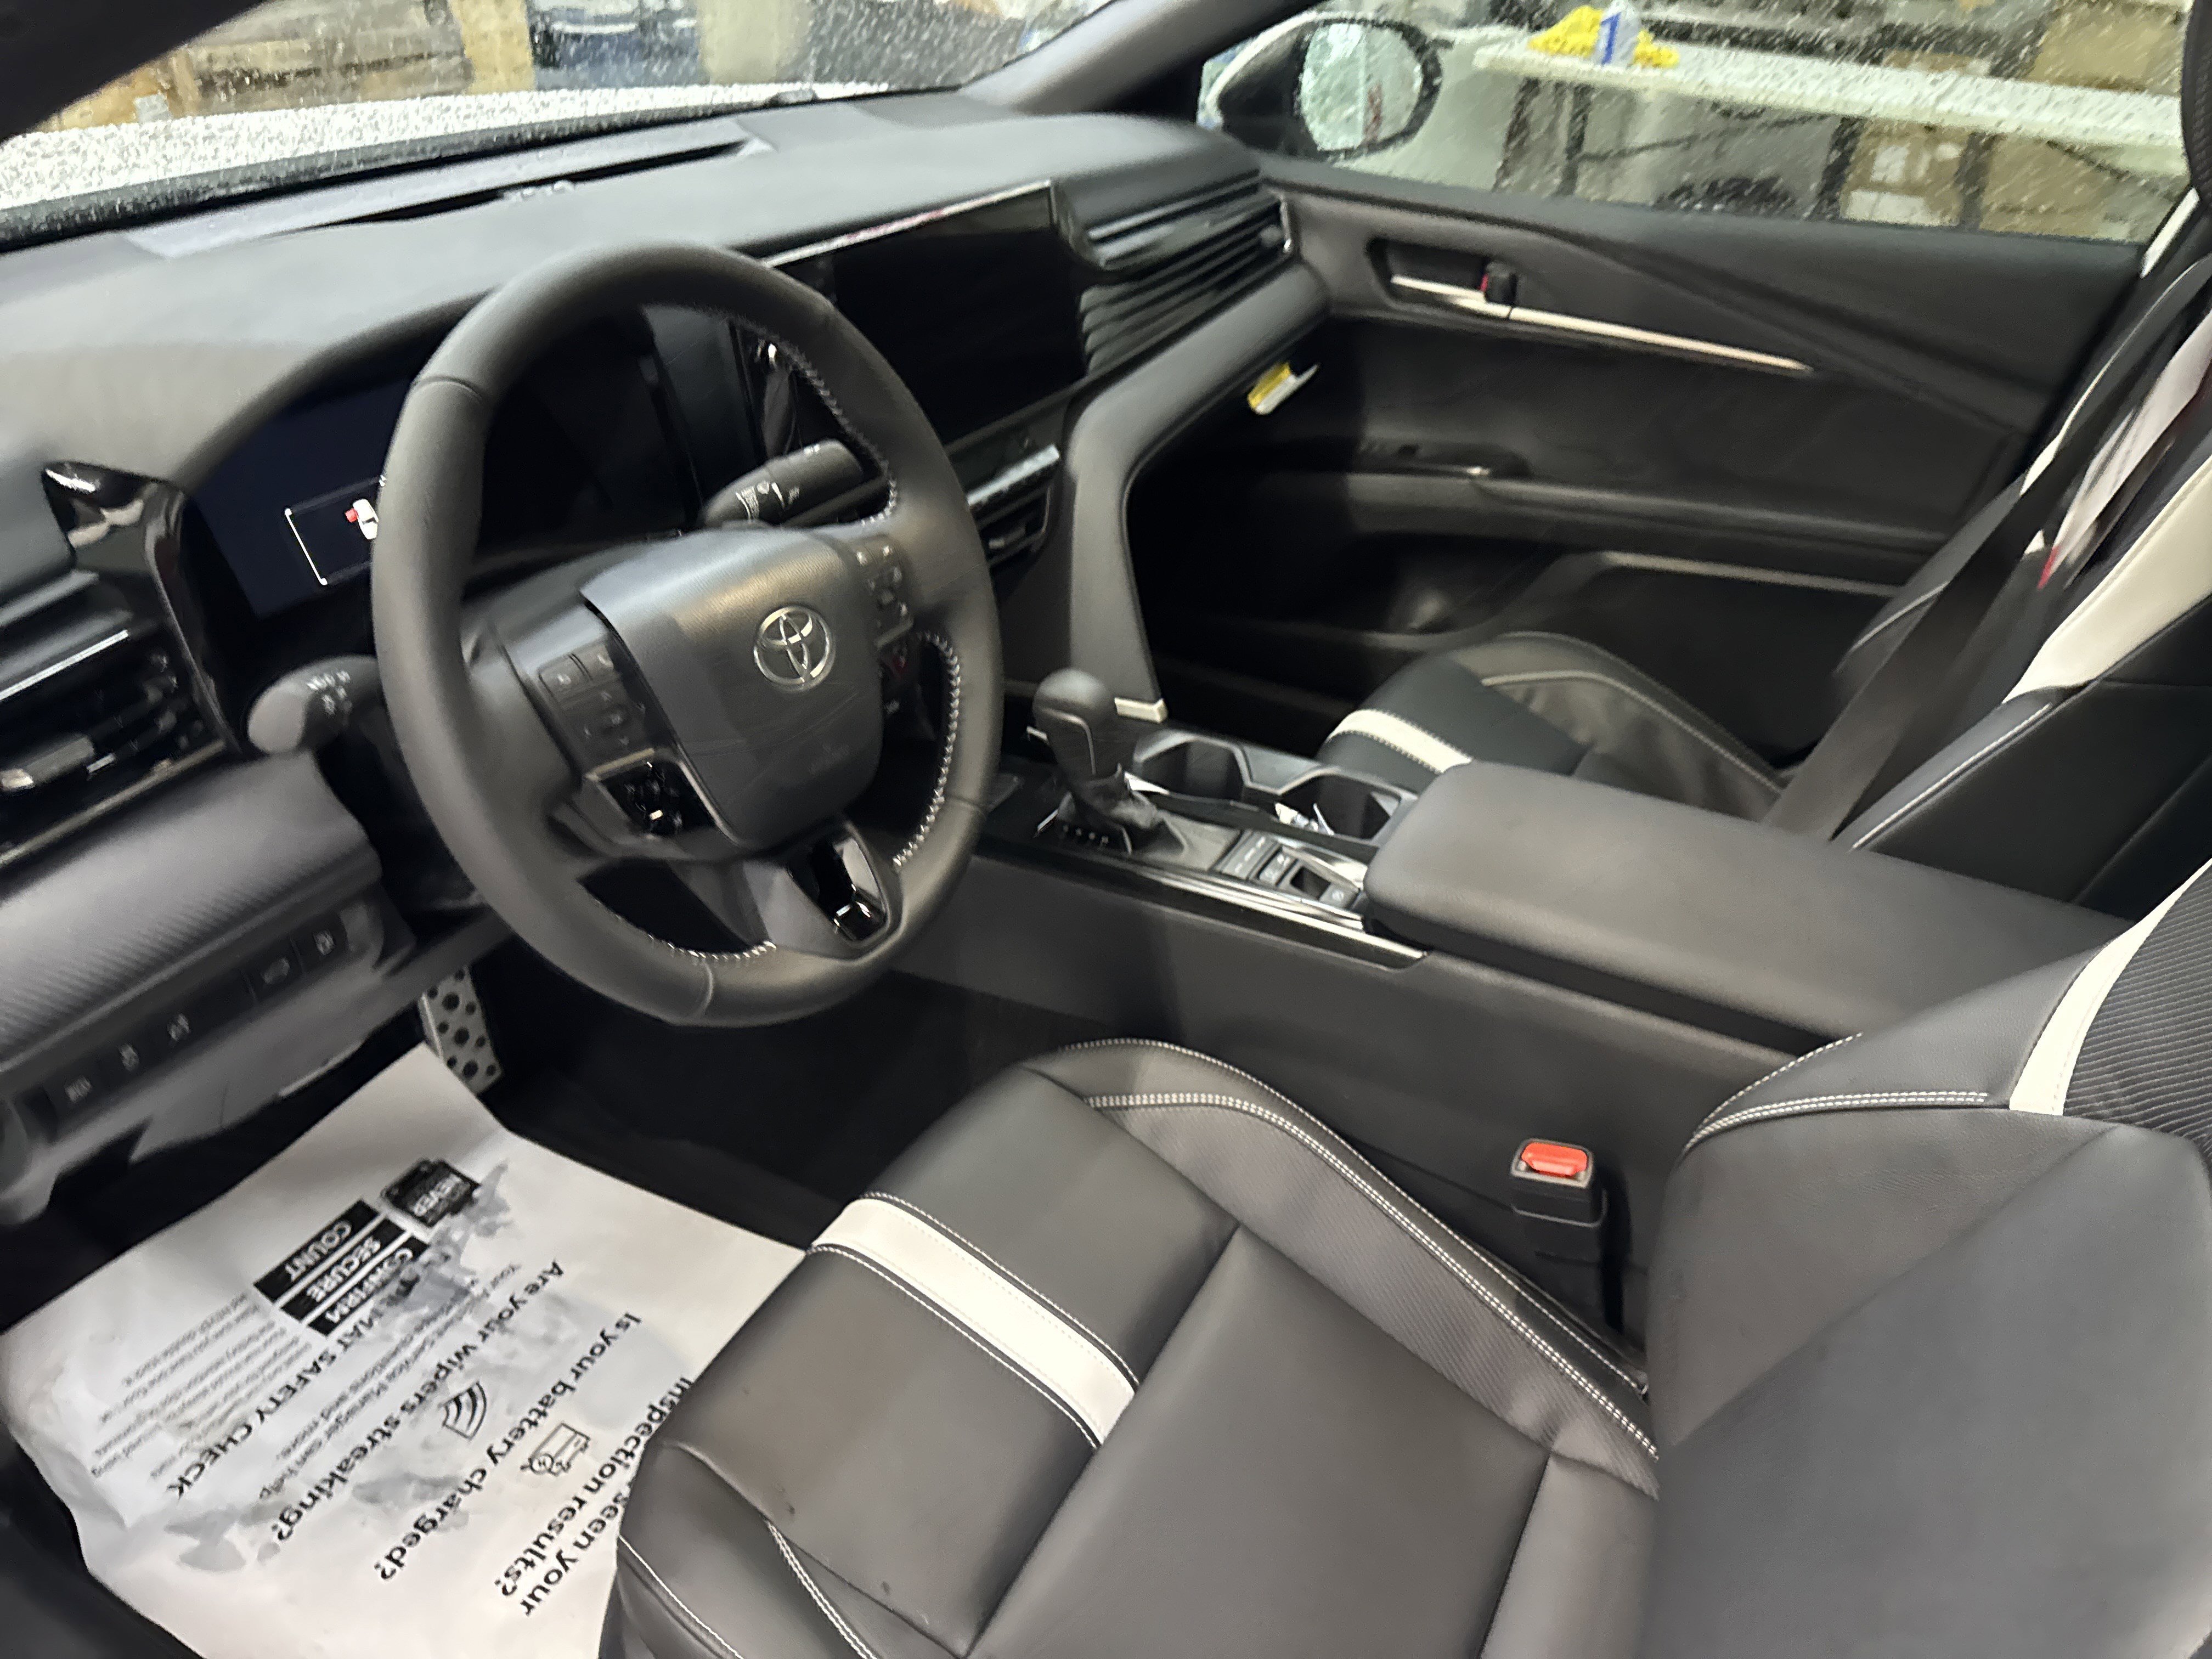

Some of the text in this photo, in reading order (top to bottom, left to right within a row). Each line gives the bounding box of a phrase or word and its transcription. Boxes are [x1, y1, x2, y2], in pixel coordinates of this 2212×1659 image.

[412, 1173, 461, 1216] NEVER
[284, 1223, 349, 1280] COUNT
[306, 1238, 380, 1301] SECURE
[324, 1249, 412, 1322] CONFIRM
[525, 1261, 563, 1293] Are
[479, 1295, 527, 1342] your
[256, 1352, 336, 1424] SAFETY
[401, 1344, 476, 1414] wipers
[168, 1425, 252, 1497] CHECK
[271, 1417, 399, 1541] streaking?
[375, 1313, 641, 1582] Is your battery charged?
[495, 1496, 586, 1595] results?
[521, 1492, 629, 1616] seen your
